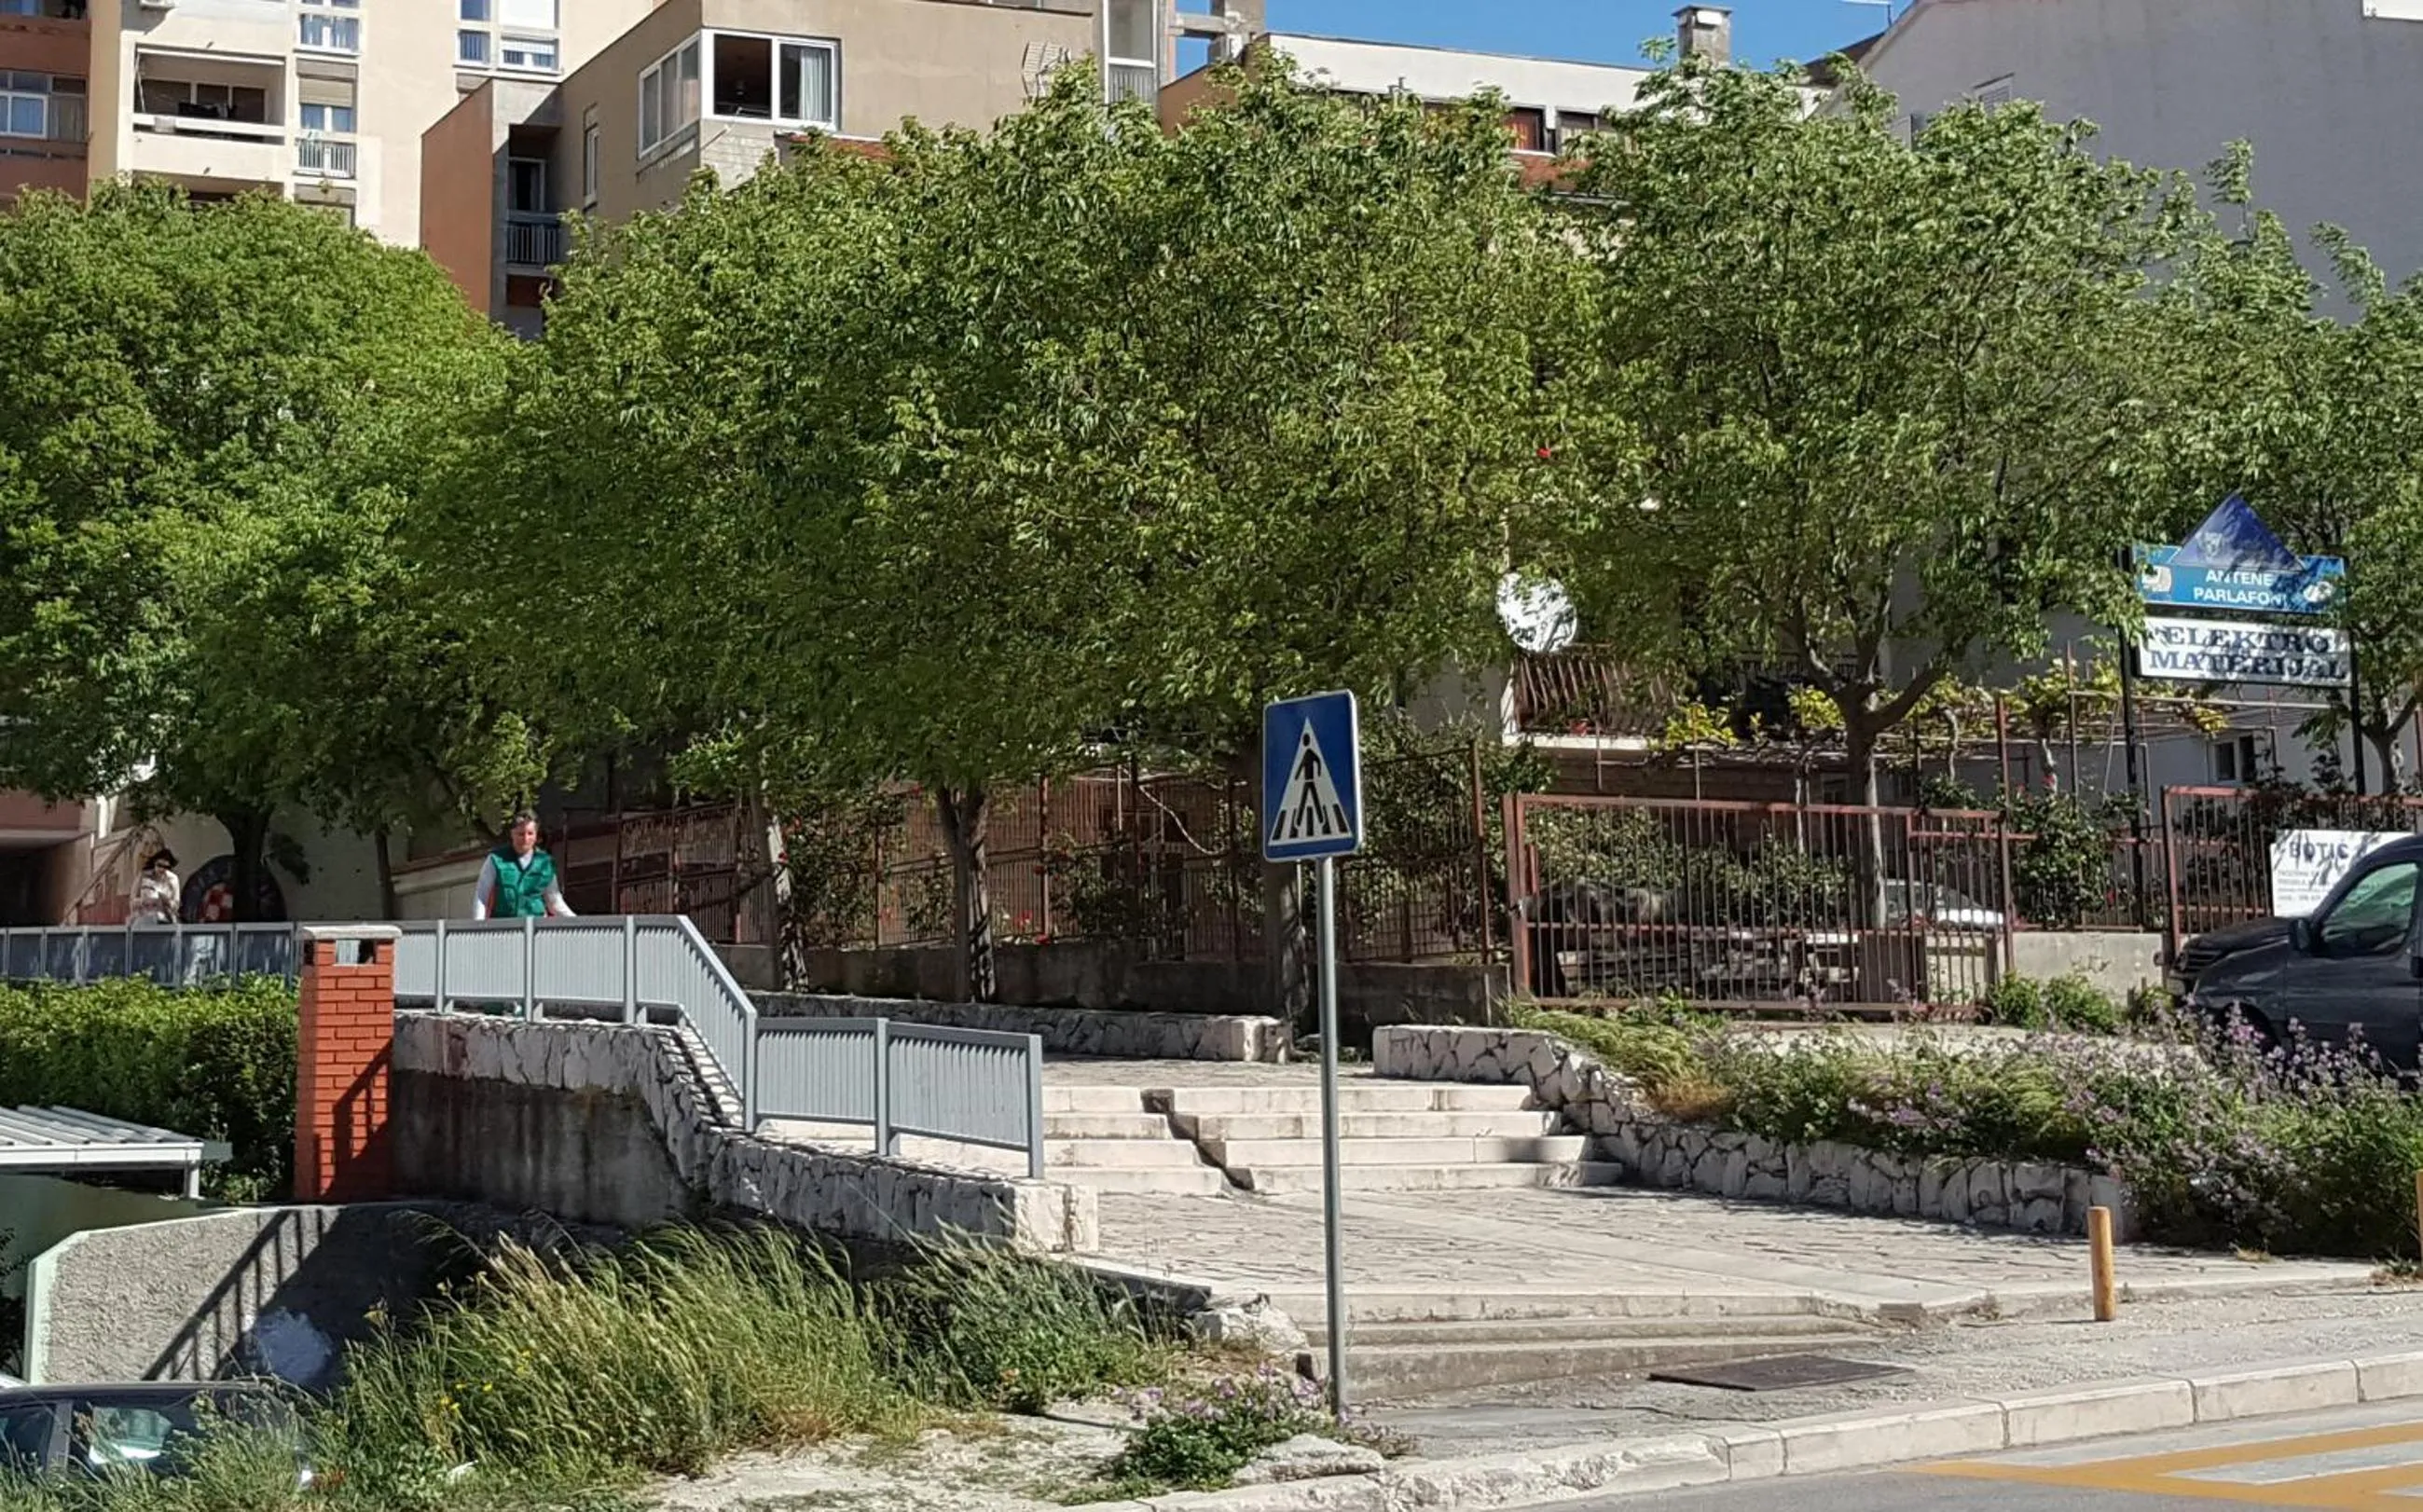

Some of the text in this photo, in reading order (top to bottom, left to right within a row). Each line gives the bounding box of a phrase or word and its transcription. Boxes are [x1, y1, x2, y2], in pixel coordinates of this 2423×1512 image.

[2206, 570, 2273, 586] ANTENE
[2164, 626, 2330, 654] ELEKTRO
[2149, 651, 2346, 680] MATERIJAL
